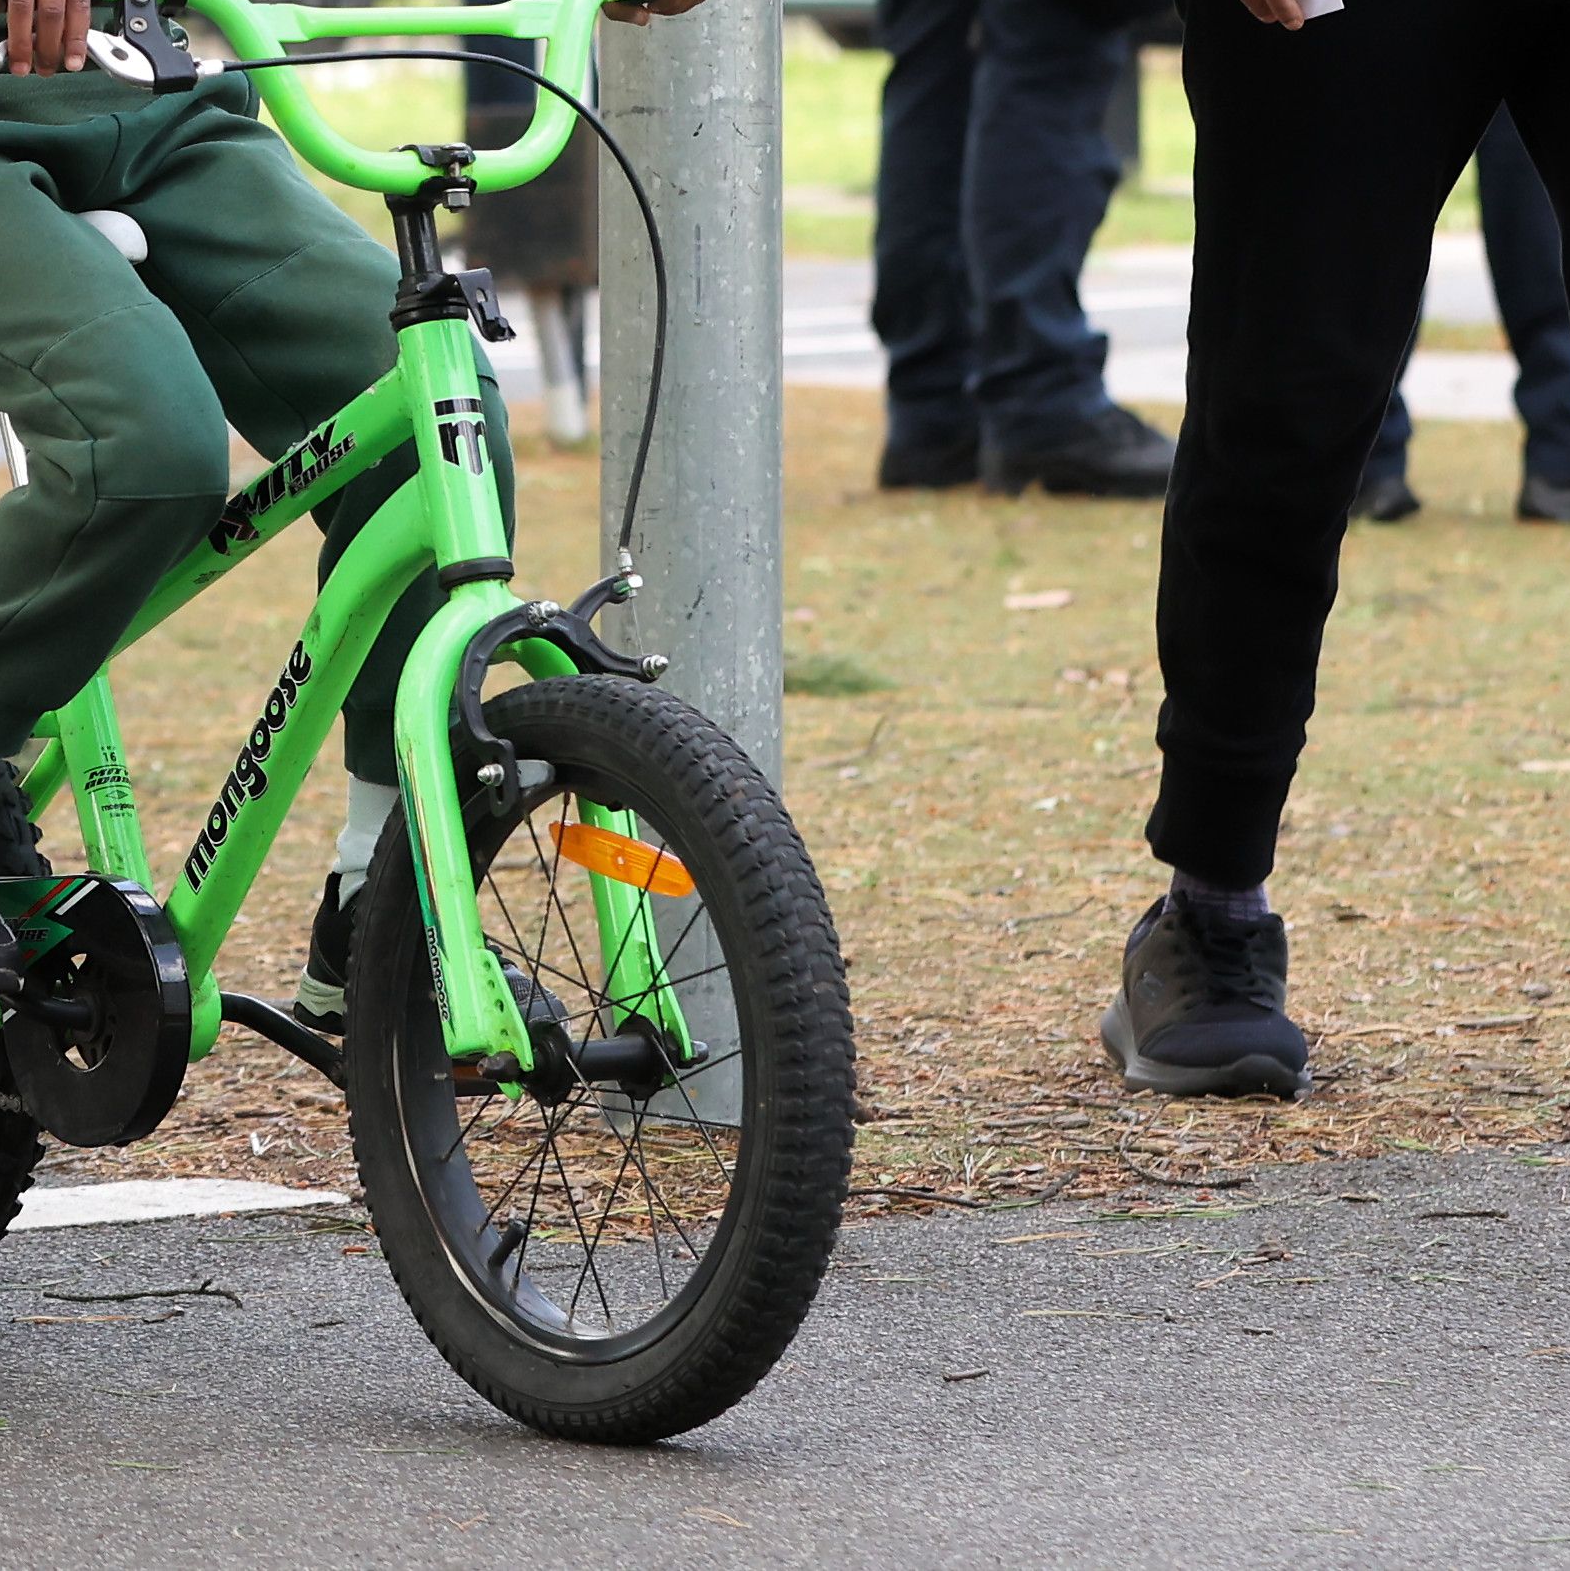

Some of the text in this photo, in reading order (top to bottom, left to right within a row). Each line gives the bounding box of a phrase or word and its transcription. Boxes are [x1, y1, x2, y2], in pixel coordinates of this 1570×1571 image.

[228, 419, 337, 516] MITY
[287, 431, 357, 497] GOOSE
[103, 752, 117, 762] 16
[183, 640, 312, 894] mongoose
[426, 927, 450, 1022] mongoose
